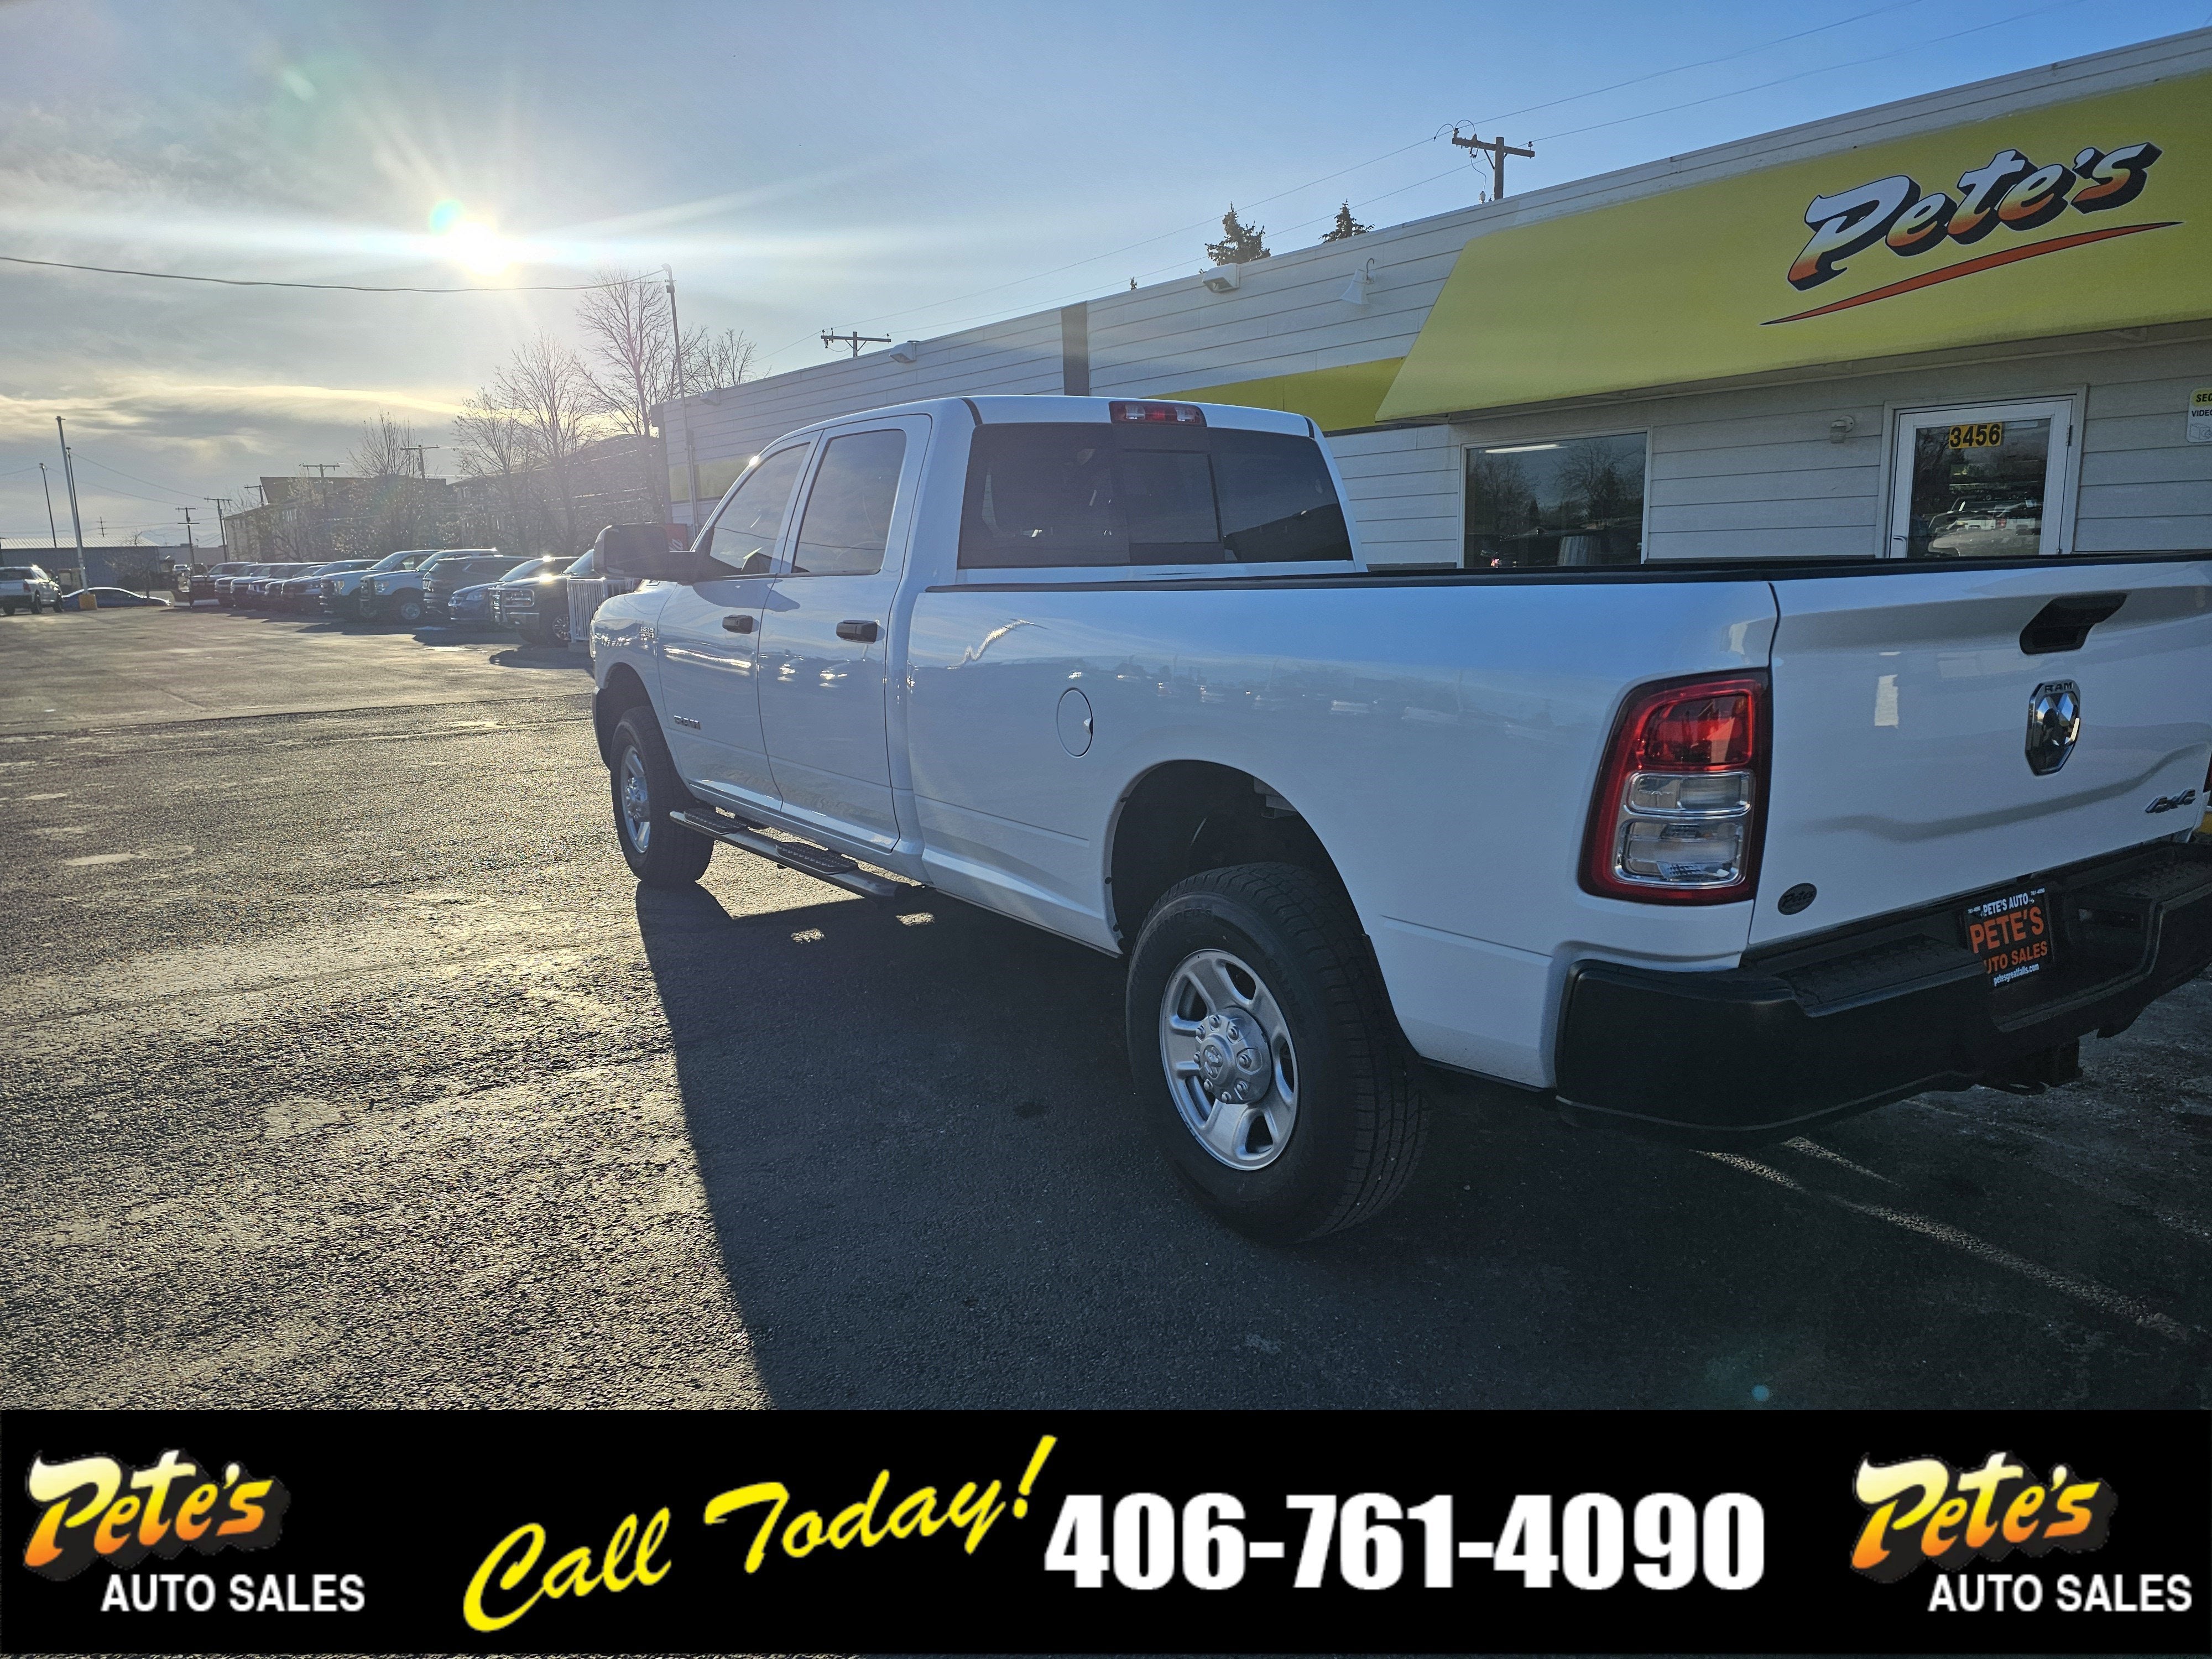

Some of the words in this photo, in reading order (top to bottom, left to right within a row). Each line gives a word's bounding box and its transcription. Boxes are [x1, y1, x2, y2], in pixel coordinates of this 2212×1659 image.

[1788, 142, 2162, 291] Pete's
[1950, 424, 2000, 447] 3456
[2044, 682, 2073, 693] RAM
[1983, 899, 2007, 915] PETE'S
[2008, 893, 2028, 909] AUTO
[1969, 906, 2044, 953] PETE'S
[1984, 953, 2008, 974] UTO
[2011, 941, 2048, 965] SALES
